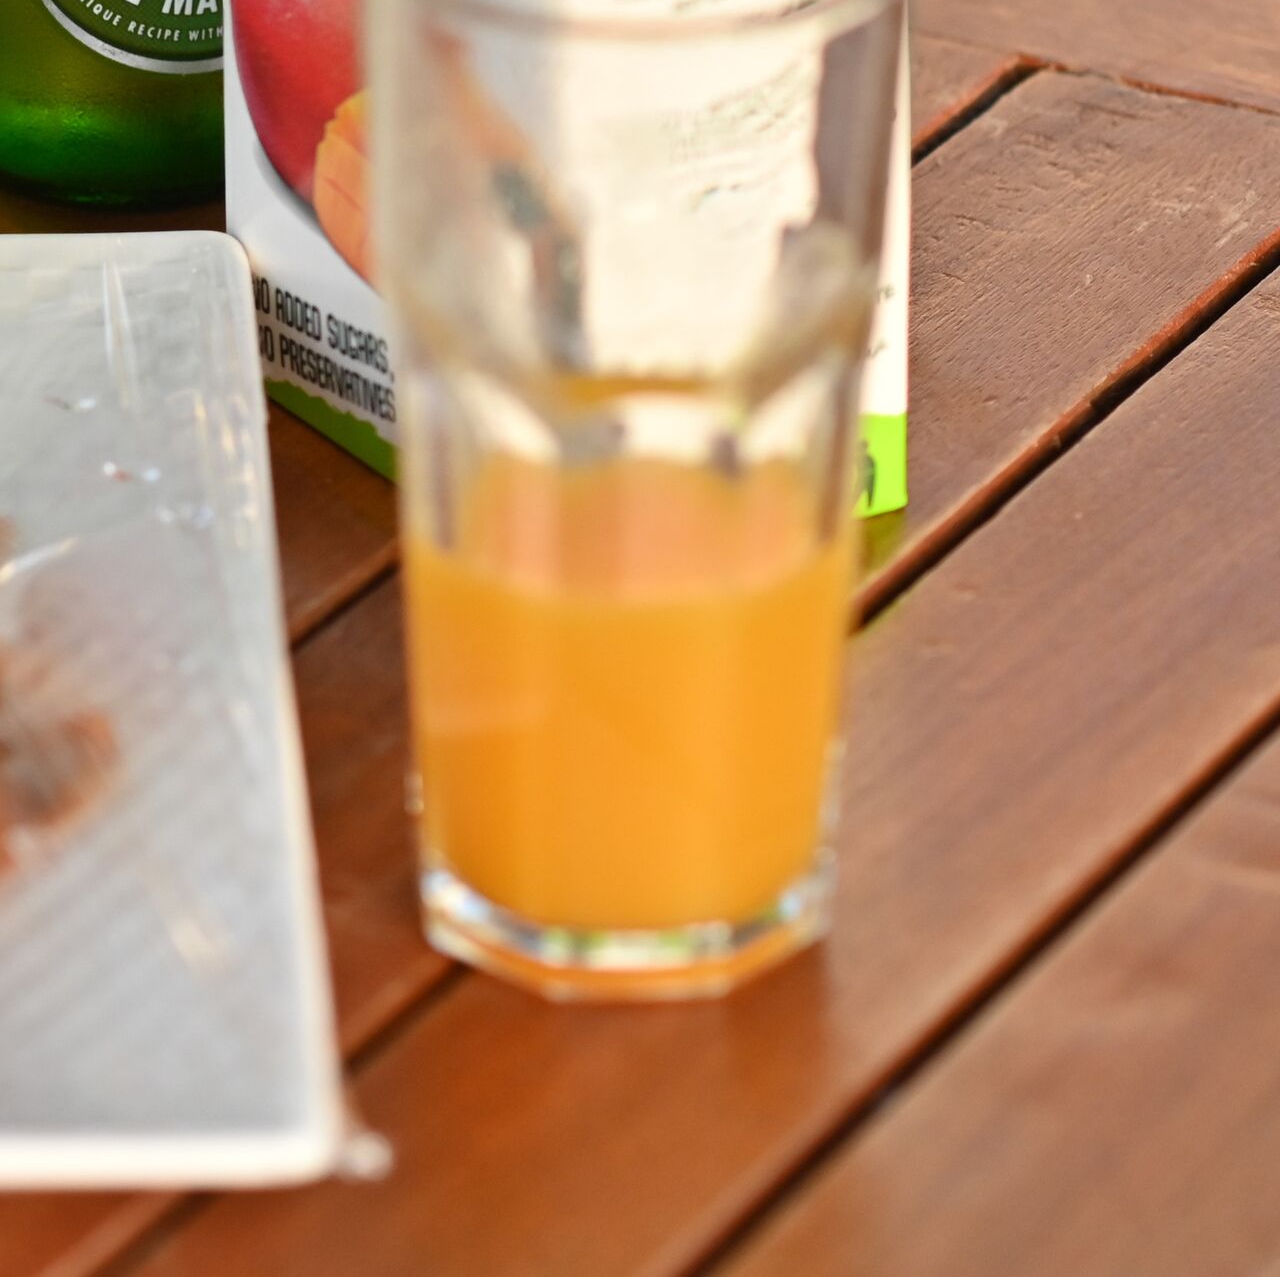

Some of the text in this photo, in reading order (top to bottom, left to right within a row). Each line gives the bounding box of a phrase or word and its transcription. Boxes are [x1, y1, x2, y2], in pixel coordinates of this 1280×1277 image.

[128, 20, 181, 42] RECIPE
[188, 25, 223, 42] WITH
[275, 287, 322, 341] ADDED
[279, 332, 397, 423] PRESERVATIVES
